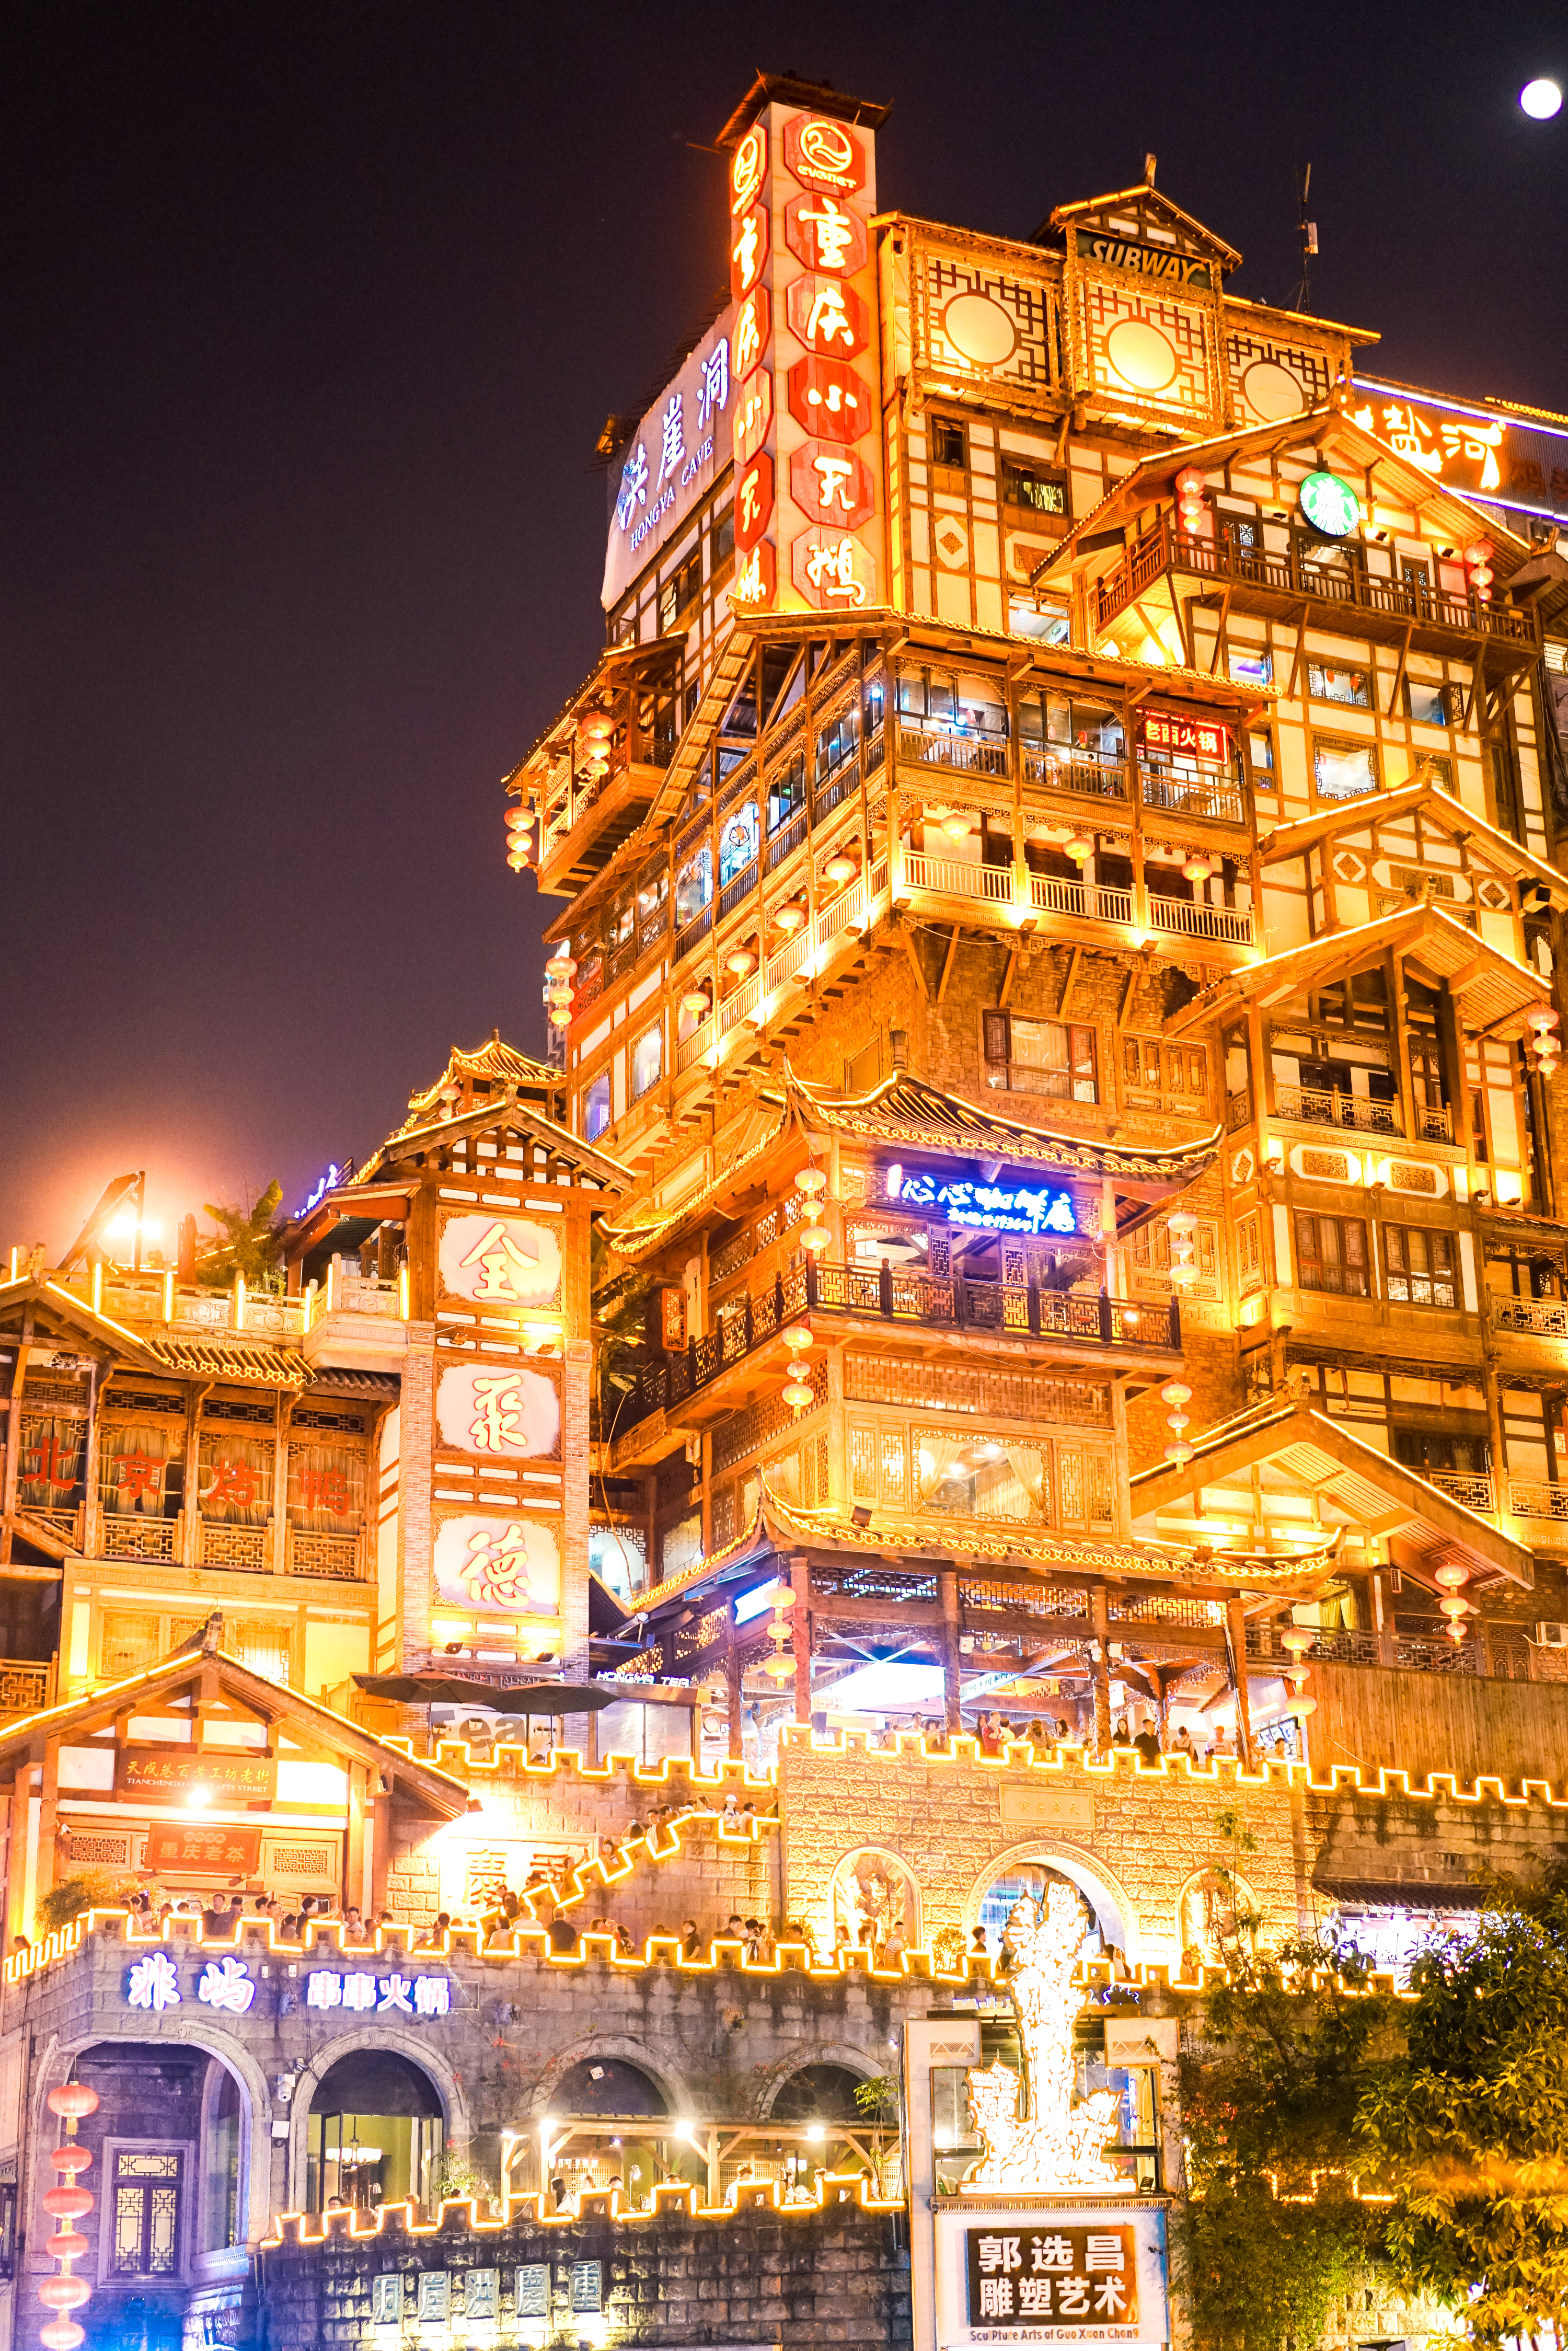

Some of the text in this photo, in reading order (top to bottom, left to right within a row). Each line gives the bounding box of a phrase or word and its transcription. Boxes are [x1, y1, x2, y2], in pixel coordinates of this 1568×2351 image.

[1083, 240, 1206, 284] SUBWAY
[617, 338, 730, 531] 洪崖洞
[630, 435, 714, 552] HONGYA CAVE
[460, 1223, 540, 1609] 全聚德
[23, 1435, 351, 1517] 北京烤鸭
[596, 1671, 690, 1688] HONGYA TEA
[237, 1784, 268, 1793] STREET
[159, 1841, 245, 1862] 重庆老茶
[307, 1971, 450, 2014] 串串火锅
[977, 2234, 1125, 2273] 郭选昌
[979, 2275, 1127, 2318] 雕塑艺术
[1020, 2329, 1042, 2340] Arts
[1044, 2329, 1054, 2340] of
[1056, 2329, 1077, 2340] Guo
[1106, 2327, 1139, 2339] Chang
